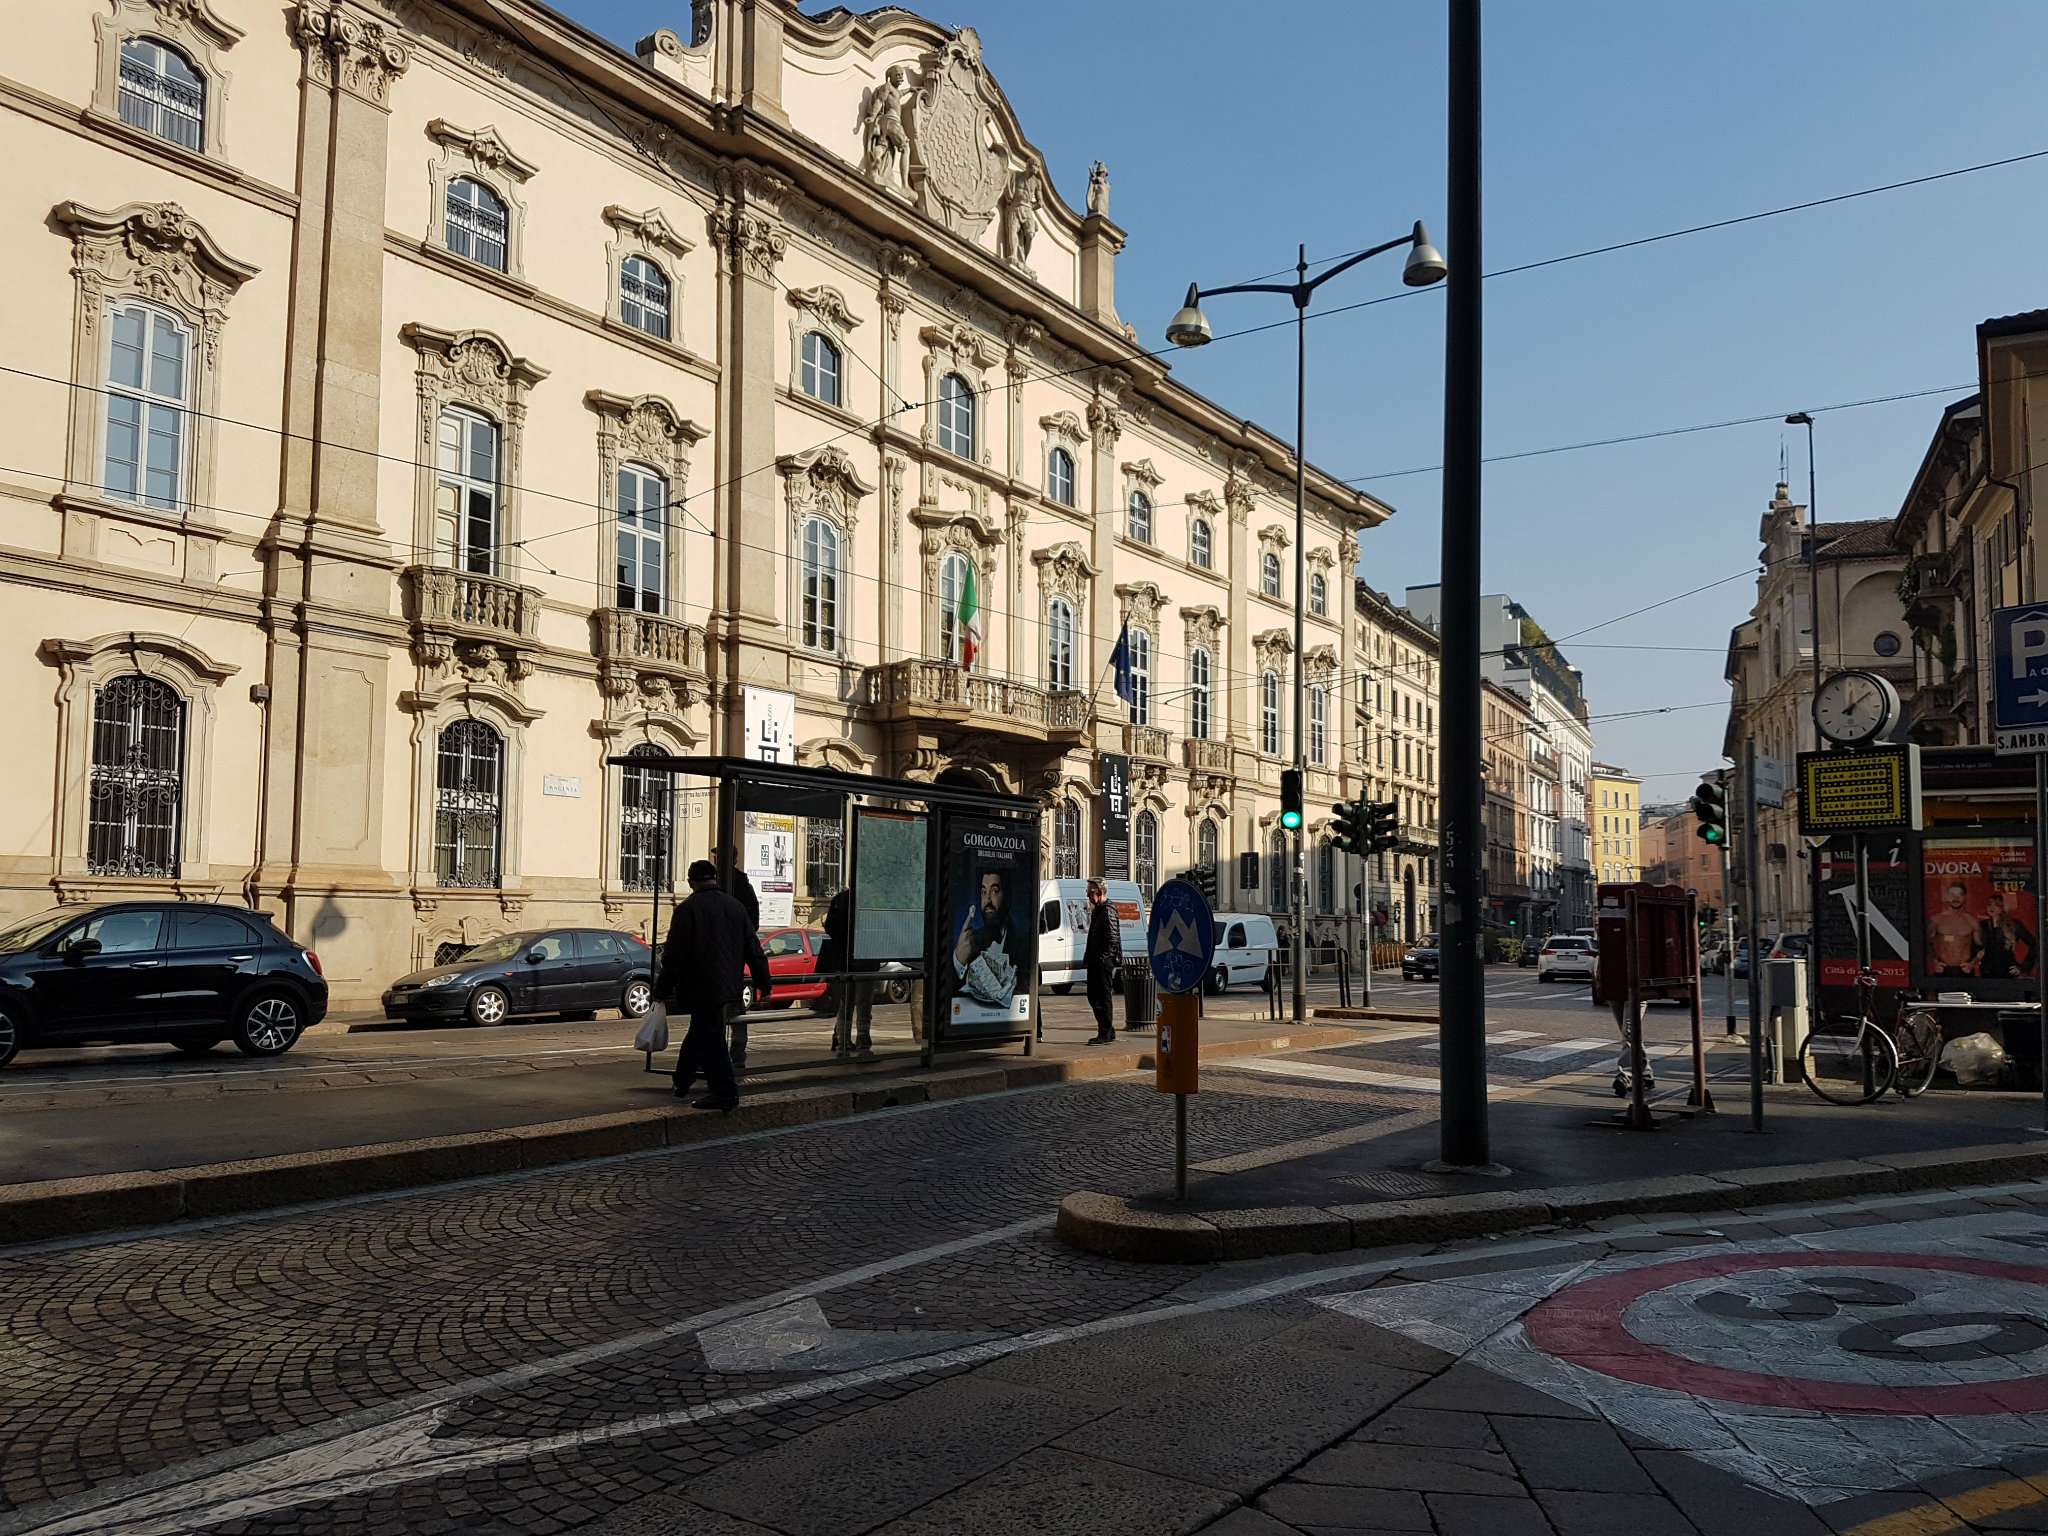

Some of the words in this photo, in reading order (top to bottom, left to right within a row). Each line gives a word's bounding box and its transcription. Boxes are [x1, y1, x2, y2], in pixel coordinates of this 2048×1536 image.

[2011, 619, 2048, 679] P
[2029, 668, 2038, 677] A
[1998, 732, 2048, 749] S.AMBR
[963, 832, 1026, 850] GORGONZOLA
[1925, 862, 1982, 874] DVORA
[1825, 966, 1845, 975] Città
[1847, 967, 1856, 975] di
[1882, 967, 1905, 976] 2015
